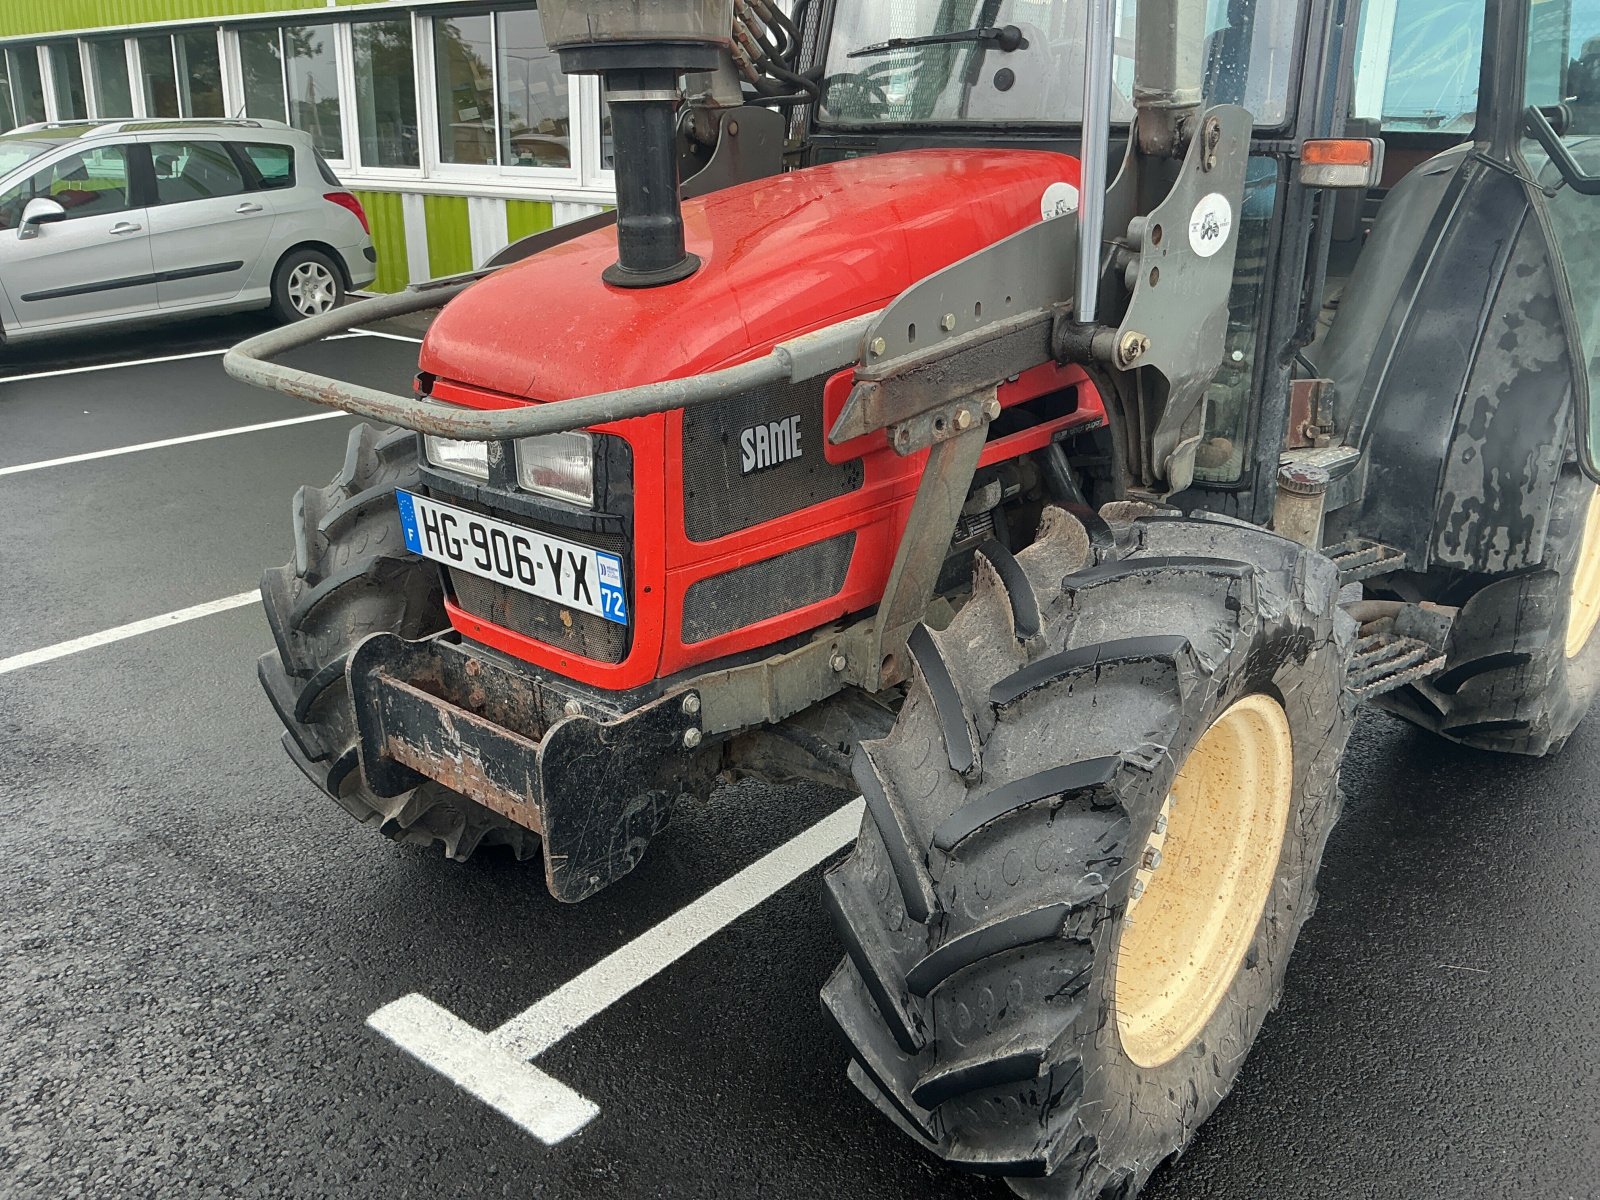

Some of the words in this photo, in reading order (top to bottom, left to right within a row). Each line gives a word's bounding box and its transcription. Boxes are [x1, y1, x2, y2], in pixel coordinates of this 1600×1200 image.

[741, 415, 802, 473] SAME
[408, 528, 414, 541] F
[421, 506, 593, 605] HG-906-YX
[601, 587, 625, 617] 72
